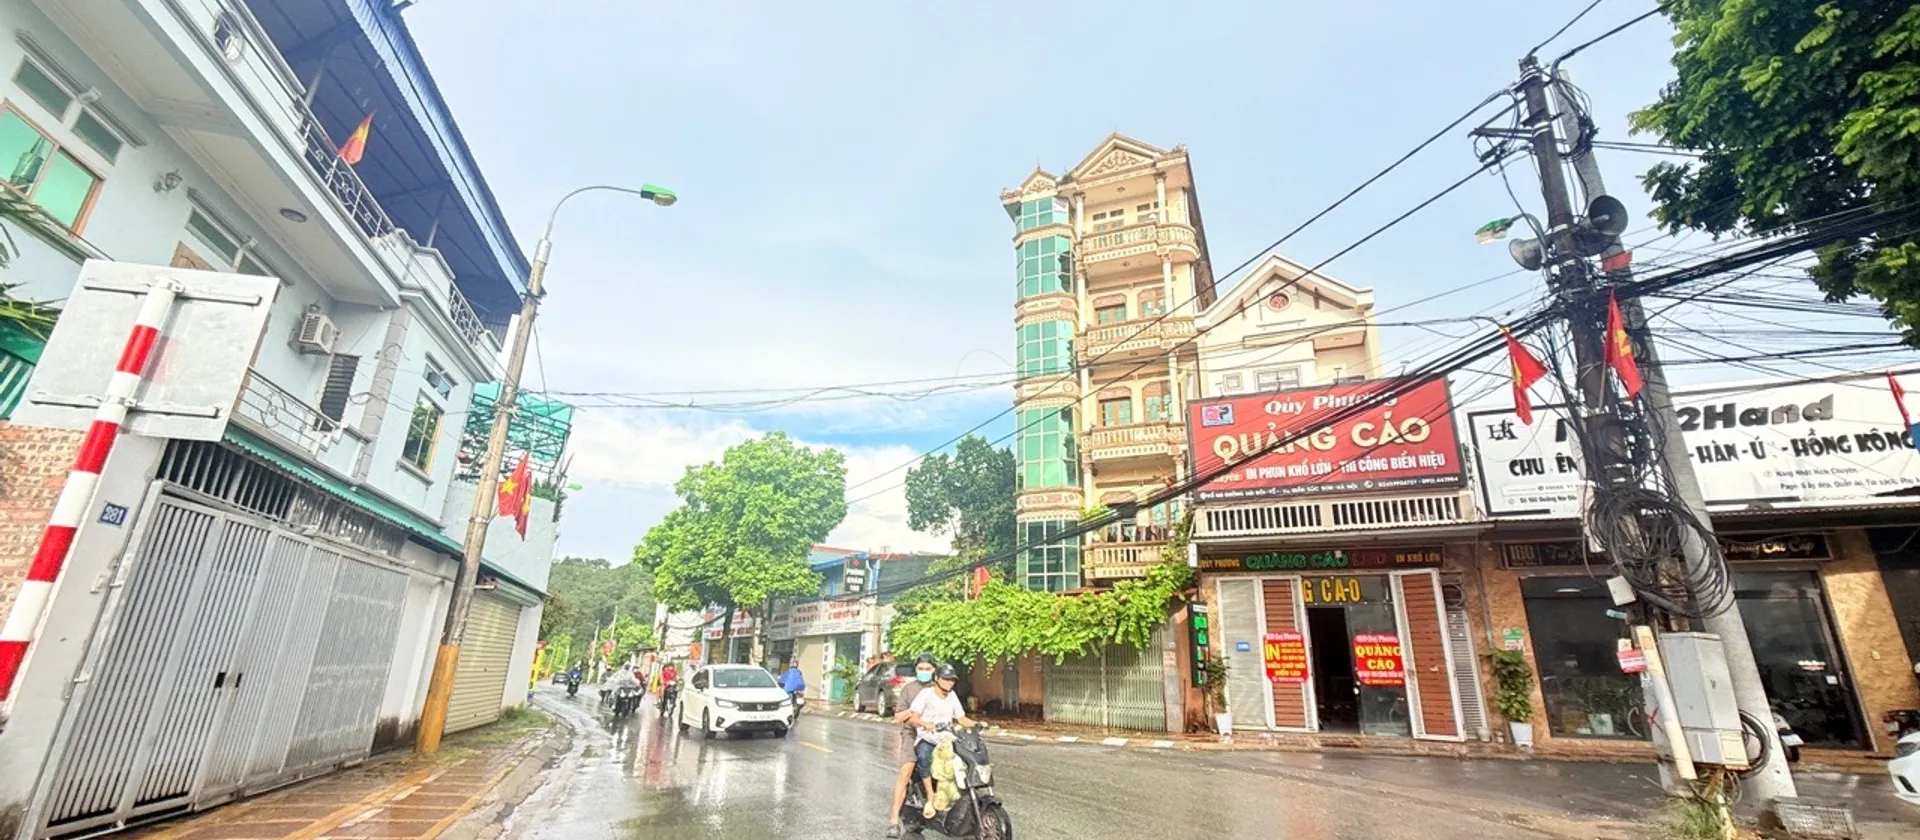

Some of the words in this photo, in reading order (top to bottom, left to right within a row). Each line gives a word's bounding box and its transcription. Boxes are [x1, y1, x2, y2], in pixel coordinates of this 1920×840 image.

[1351, 411, 1431, 448] CÁO
[1696, 440, 1740, 463] HÀN
[1245, 467, 1258, 480] IN
[1258, 463, 1286, 479] PHUN
[1359, 456, 1388, 472] CÔNG
[1418, 450, 1446, 469] HIỆU
[1508, 452, 1578, 477] CHUÊN
[101, 505, 124, 524] 281
[1246, 552, 1307, 570] QUẢNG
[1264, 642, 1281, 661] IN
[1366, 657, 1396, 670] CÁO
